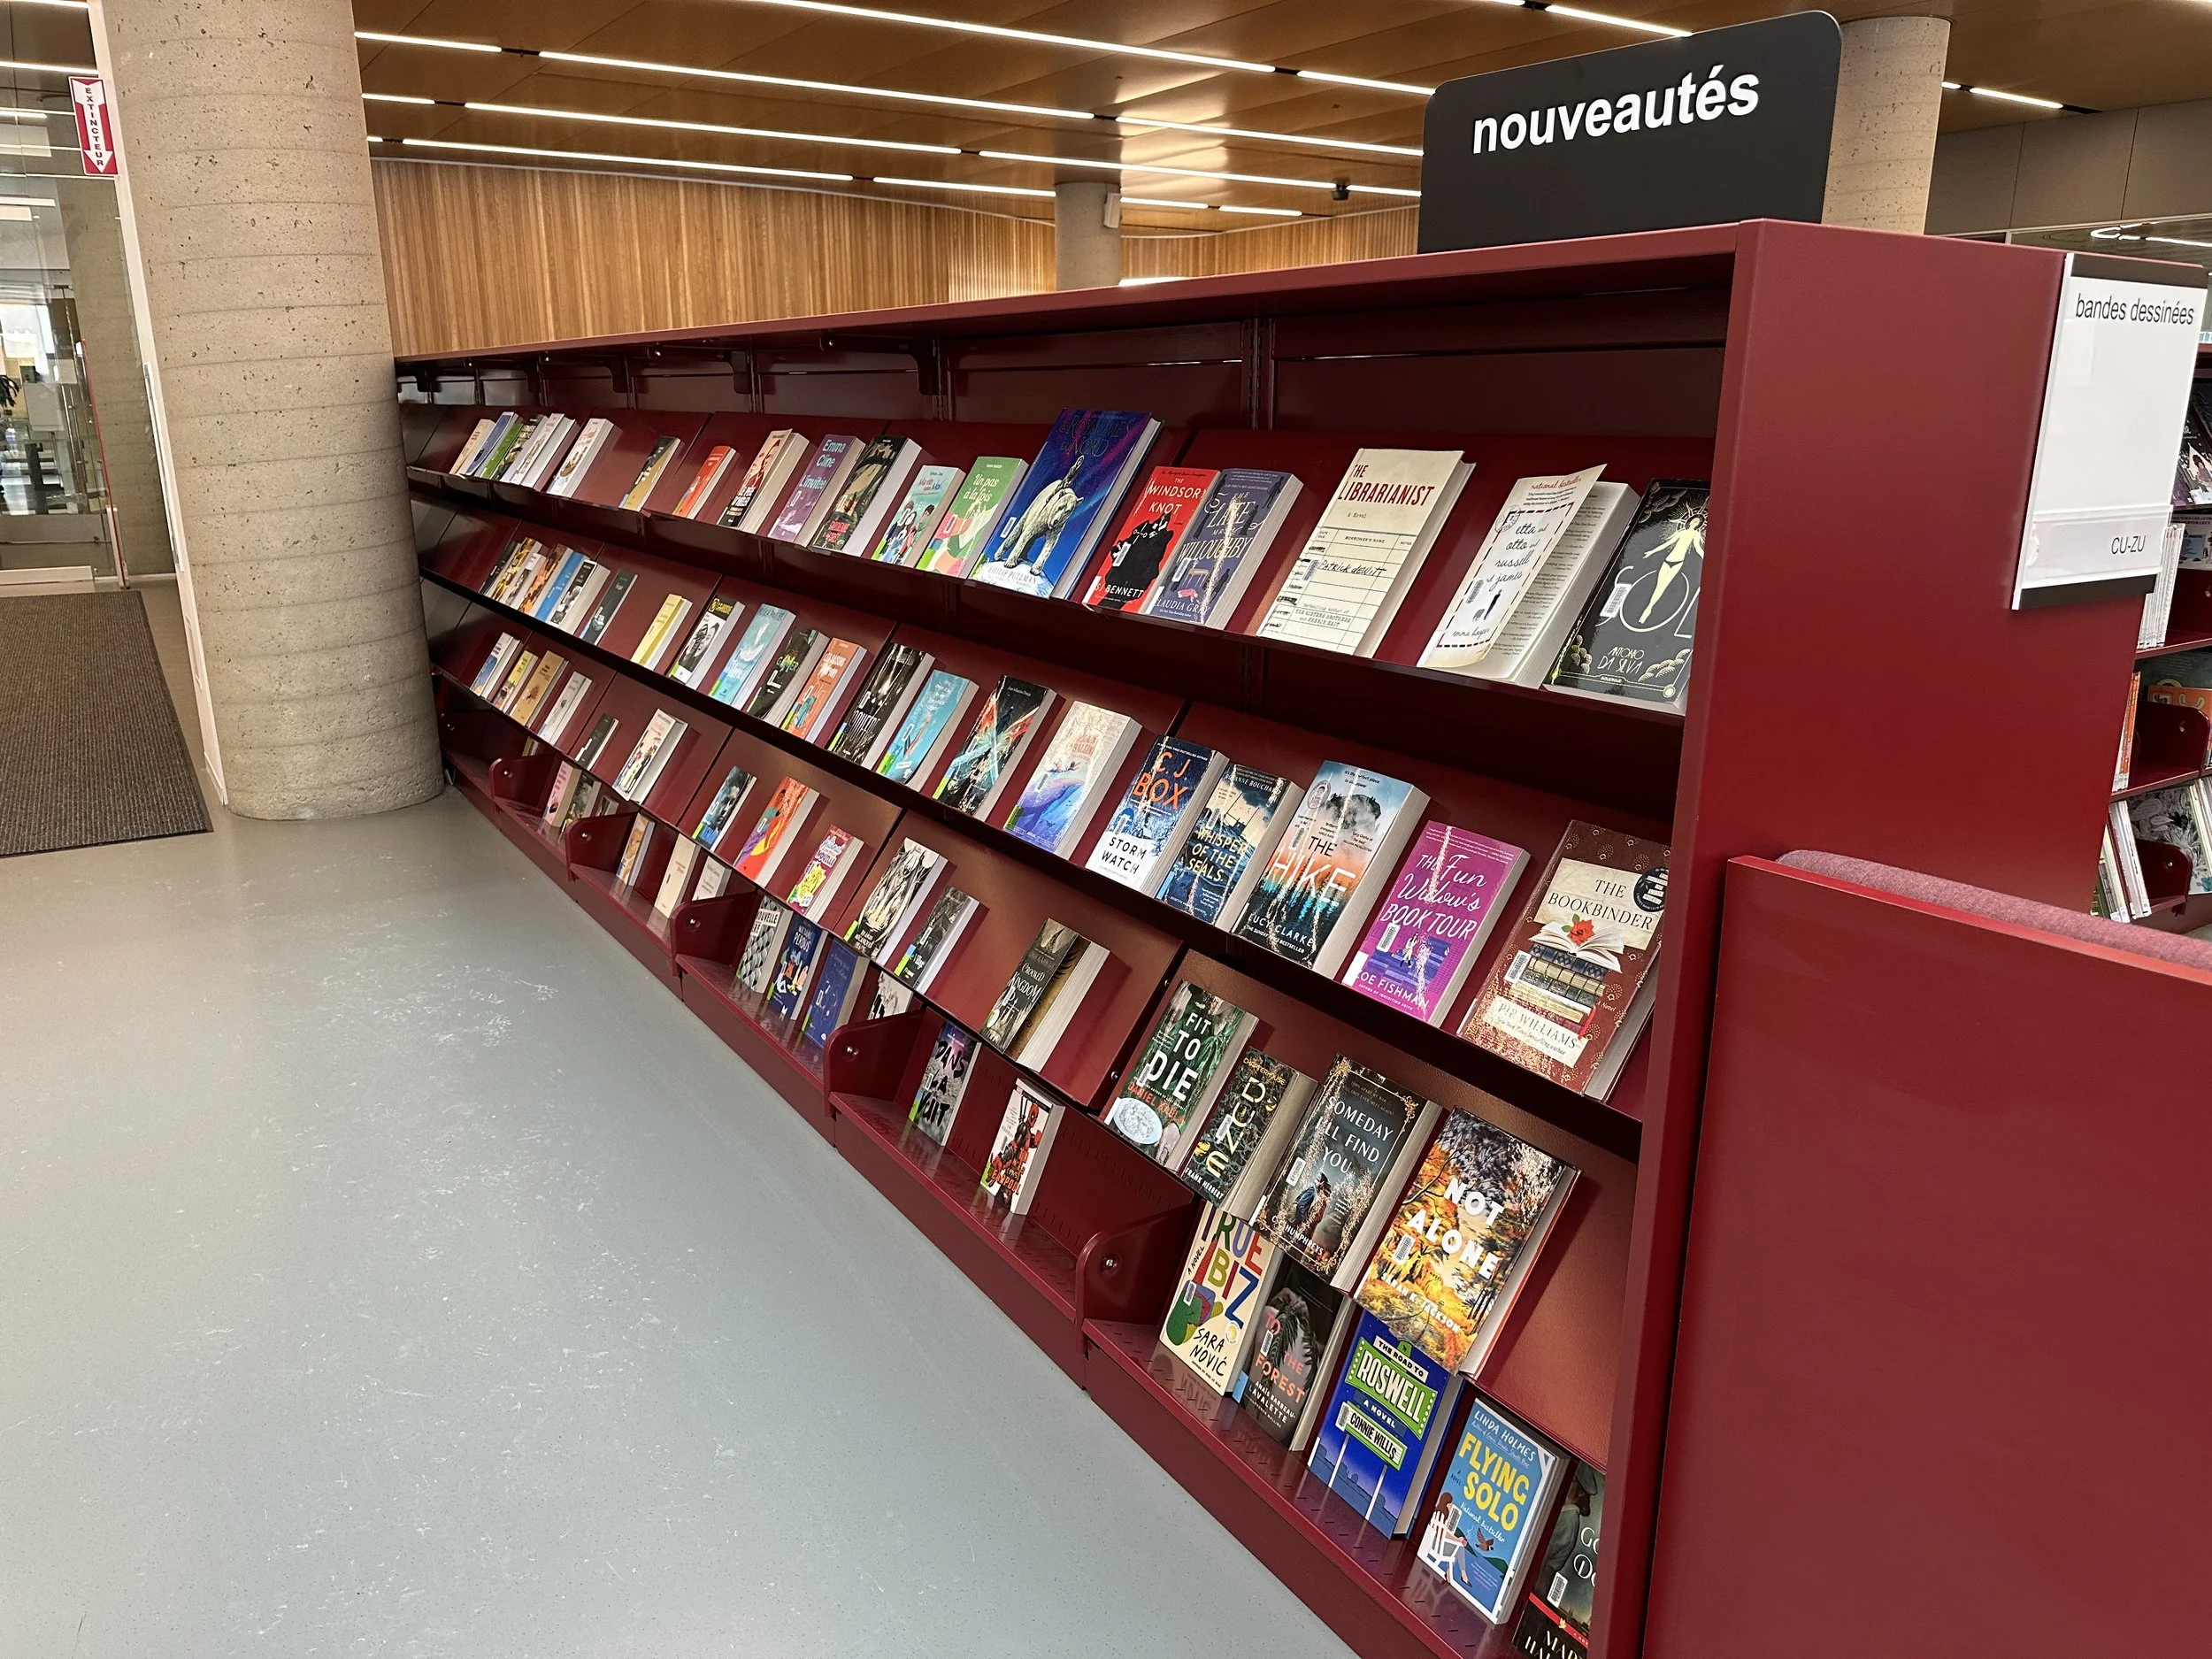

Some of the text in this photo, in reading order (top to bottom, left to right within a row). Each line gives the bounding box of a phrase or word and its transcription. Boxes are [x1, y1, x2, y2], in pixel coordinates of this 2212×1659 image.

[1471, 64, 1761, 154] nouveautés
[85, 88, 104, 166] EXTINCTEUR
[2076, 293, 2194, 326] bandes dessinées
[817, 454, 836, 468] Cline
[822, 439, 846, 453] Emma
[980, 479, 999, 490] pas
[1353, 464, 1369, 478] THE
[1148, 480, 1202, 499] WINDSOR
[1337, 481, 1435, 506] LIBRARIANIST
[1148, 502, 1183, 515] KNOT
[1516, 523, 1535, 534] etta
[1494, 549, 1535, 567] russell
[1506, 539, 1528, 550] otto
[2111, 535, 2147, 555] CU-ZU
[1104, 584, 1145, 598] BENNETT
[1155, 598, 1184, 611] LAUDIA
[1597, 656, 1616, 671] DA
[1133, 772, 1188, 810] BOX
[1109, 836, 1147, 860] STORM
[1197, 826, 1248, 854] WHISPER
[1309, 836, 1337, 857] THE
[1102, 850, 1140, 875] WATCH
[1192, 843, 1236, 869] OF THE
[1440, 854, 1487, 887] Fun
[1266, 847, 1357, 907] HIKE
[1398, 872, 1481, 911] Widow's
[1595, 879, 1626, 898] THE
[1380, 903, 1478, 941] BOOK TOUR
[1548, 892, 1653, 930] BOOKBINDER
[1248, 914, 1314, 948] LUCY CLARKE
[1279, 939, 1305, 954] BESTSELLER
[1010, 972, 1042, 1002] KINGDOM
[1378, 979, 1430, 1010] FISHMAN
[1601, 1002, 1617, 1012] Novel
[1186, 1012, 1211, 1035] FIT
[1519, 1013, 1578, 1049] WILLIAMS
[935, 1041, 965, 1079] DANS
[1173, 1029, 1202, 1061] TO
[1146, 1049, 1199, 1102] DIE
[1127, 1081, 1157, 1107] DANIEL
[1326, 1096, 1394, 1141] SOMEDAY
[1323, 1147, 1352, 1173] YOU
[1345, 1133, 1379, 1163] FIND
[1185, 1167, 1225, 1200] FRANK HERBERT
[1443, 1177, 1504, 1226] NOT
[1285, 1225, 1325, 1256] HUMPHREYS
[1407, 1208, 1499, 1279] ALONE
[1192, 1246, 1204, 1269] NOVEL
[1208, 1248, 1259, 1329] BIZ
[1380, 1272, 1409, 1296] SARAH
[1420, 1300, 1462, 1333] JACKSON
[1265, 1311, 1281, 1336] TO
[1194, 1328, 1225, 1352] SARA
[1189, 1344, 1227, 1376] NOVIĆ
[1284, 1351, 1304, 1375] THE
[1379, 1340, 1424, 1378] THE ROAD TO
[1256, 1355, 1306, 1403] FOREST
[1356, 1350, 1425, 1424] ROSWELL
[1249, 1386, 1287, 1424] LAVALETTE
[1270, 1394, 1296, 1418] BARBEAU-
[1371, 1405, 1395, 1428] NOVEL
[1350, 1412, 1397, 1461] CONNIE WILLIS
[1474, 1410, 1536, 1462] LINDA HOLMES
[1459, 1432, 1530, 1506] FLYING
[1463, 1471, 1519, 1531] SOLO
[1460, 1502, 1505, 1543] National bestseller
